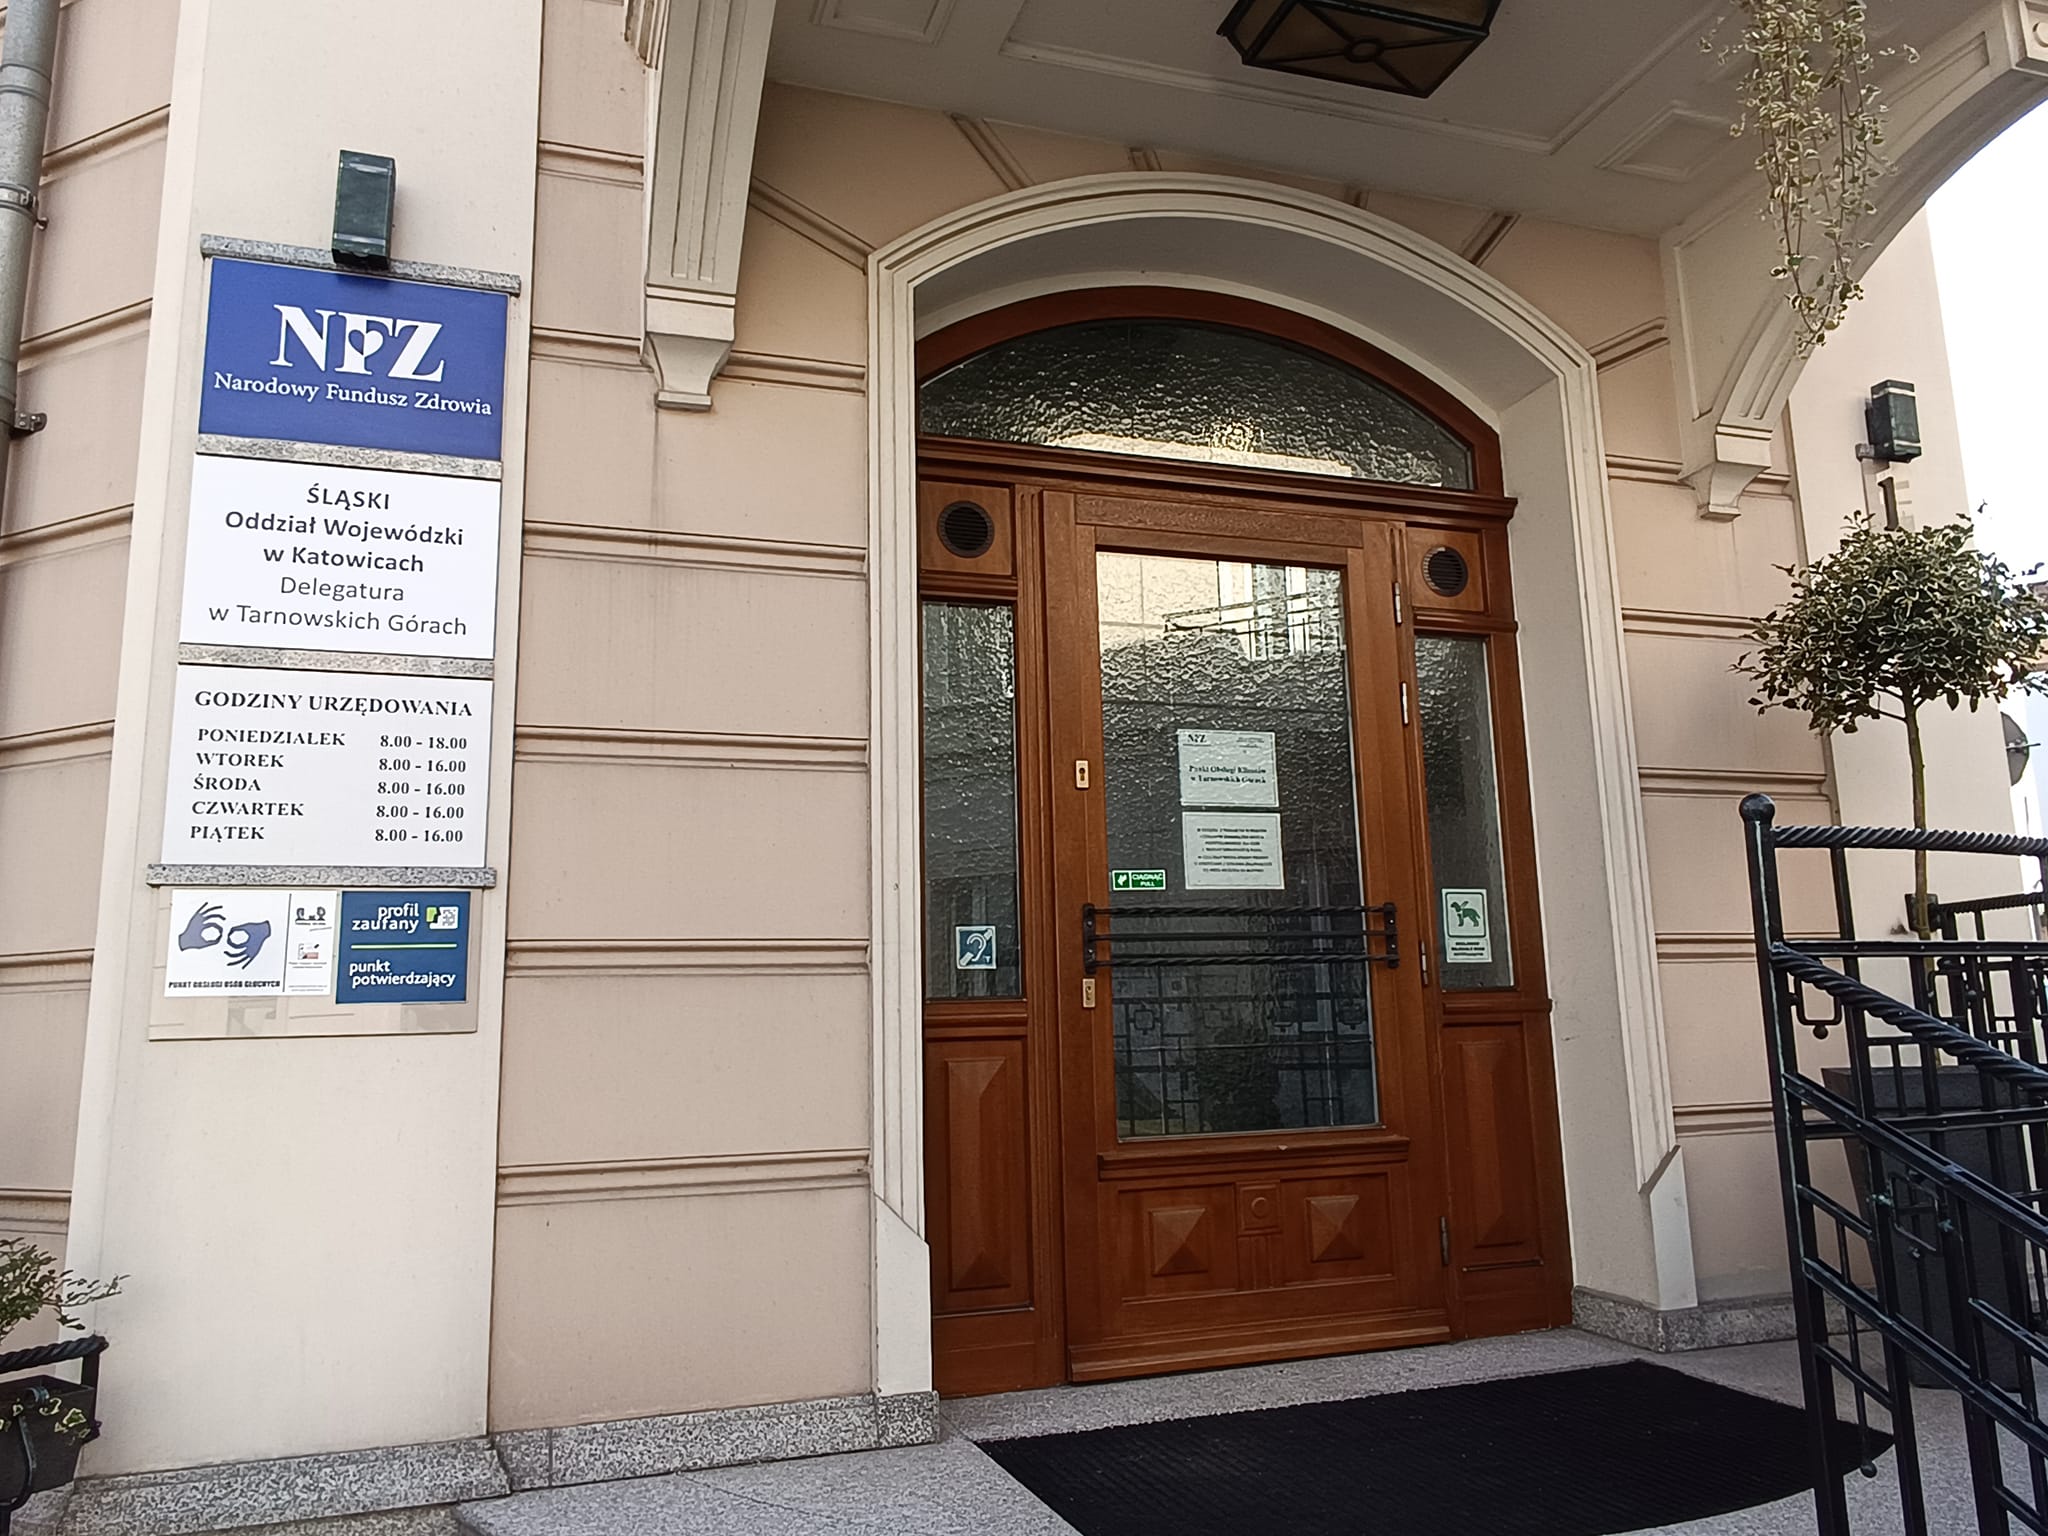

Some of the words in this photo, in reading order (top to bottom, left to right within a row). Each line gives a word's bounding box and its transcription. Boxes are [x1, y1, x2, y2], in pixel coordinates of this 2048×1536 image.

[269, 304, 446, 383] NFZ
[214, 372, 319, 403] Narodowy
[326, 384, 408, 407] Fundusz
[415, 392, 492, 416] Zdrowia
[307, 483, 390, 510] ŚLĄSKI
[225, 510, 316, 534] Oddział
[324, 517, 463, 546] Wojewódzki
[264, 547, 284, 563] w
[292, 546, 424, 573] Katowicach
[280, 576, 405, 602] Delegatura
[209, 606, 229, 621] w
[237, 605, 379, 631] Tarnowskich
[388, 614, 467, 636] Górach
[195, 691, 302, 710] GODZINY
[309, 695, 472, 717] URZĘDOWANIA
[380, 734, 412, 749] 8.00
[428, 736, 467, 750] 18.00
[196, 752, 284, 768] WTOREK
[379, 758, 410, 772] 8.00
[427, 759, 466, 773] 16.00
[193, 773, 261, 792] ŚRODA
[377, 781, 409, 795] 8.00
[426, 783, 465, 796] 16.00
[192, 801, 304, 817] CZWARTEK
[376, 805, 408, 818] 8.00
[425, 806, 464, 819] 16.00
[190, 826, 264, 843] PIĄTEK
[375, 828, 407, 842] 8.00
[424, 829, 463, 843] 16.00
[378, 903, 419, 920] profil
[352, 918, 419, 934] zaufany
[349, 960, 390, 976] punkt
[352, 972, 455, 989] potwierdzający
